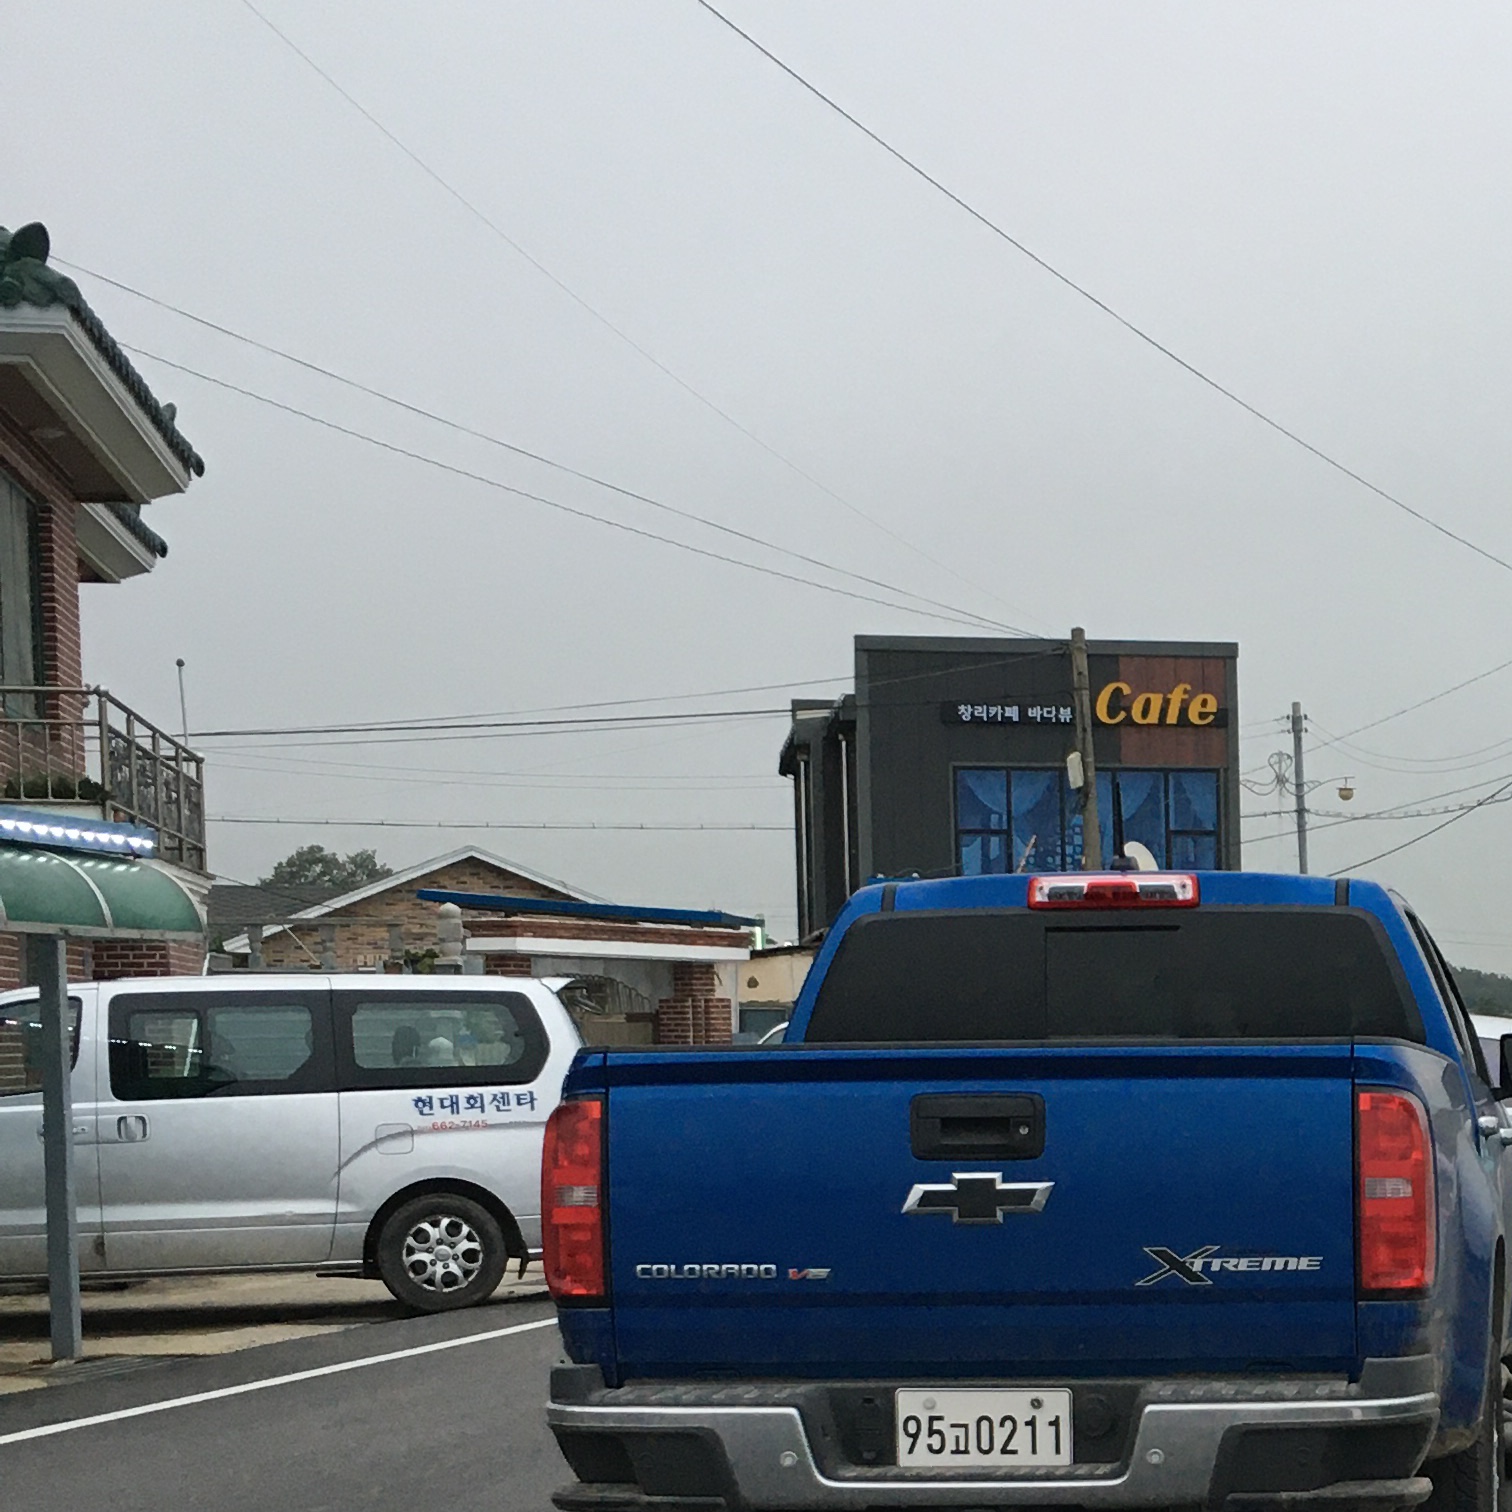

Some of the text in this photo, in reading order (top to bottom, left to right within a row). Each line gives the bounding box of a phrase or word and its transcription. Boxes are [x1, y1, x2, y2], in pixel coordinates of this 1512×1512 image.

[957, 704, 1019, 722] 창리카페
[1096, 682, 1218, 725] Cafe
[412, 1091, 538, 1116] 현대회센타
[432, 1119, 488, 1131] 662-7145
[636, 1264, 777, 1279] COLORADO
[1134, 1245, 1324, 1286] XTREME
[902, 1414, 1061, 1455] 95고0211
